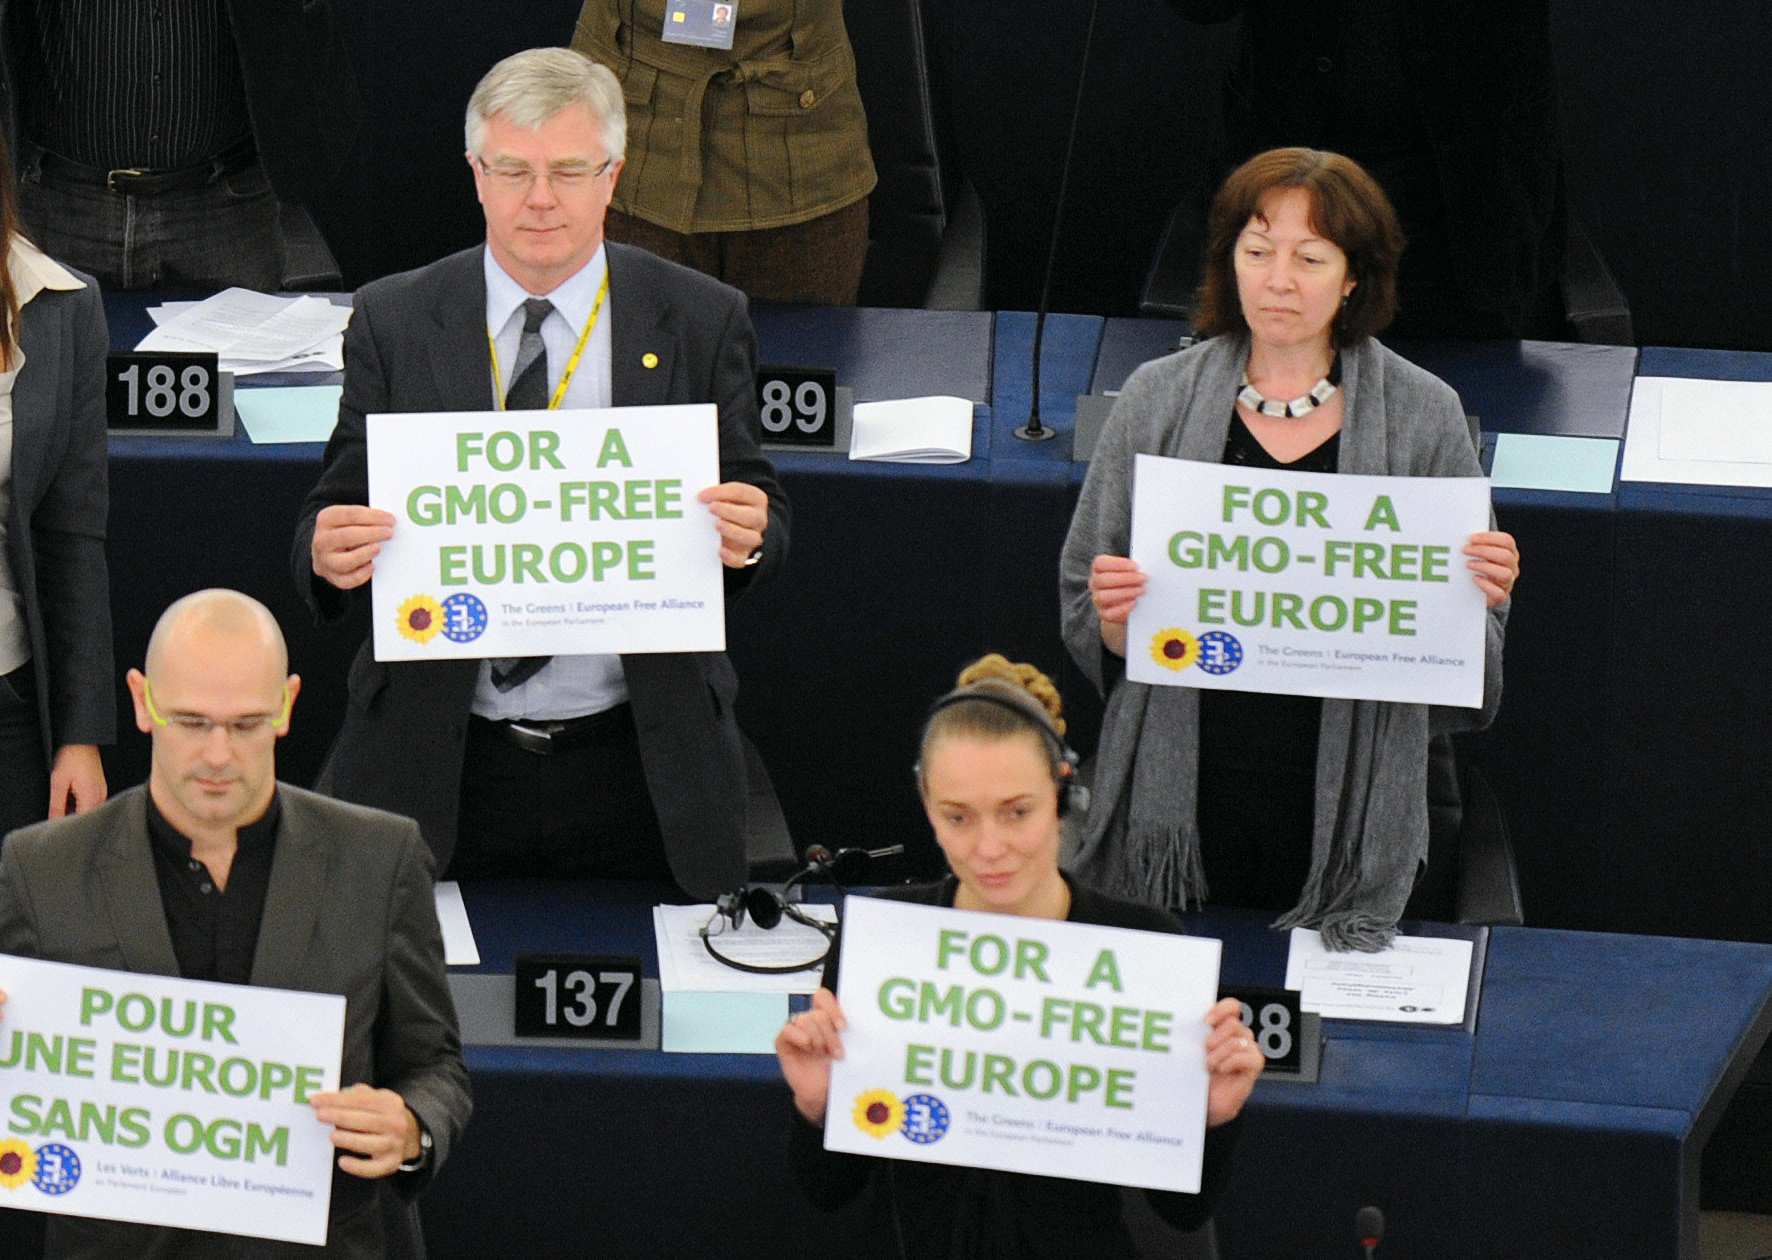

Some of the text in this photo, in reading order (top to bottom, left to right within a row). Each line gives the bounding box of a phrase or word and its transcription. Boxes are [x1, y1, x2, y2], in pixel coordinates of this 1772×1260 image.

[119, 365, 210, 417] 188
[761, 381, 826, 432] 89
[457, 429, 631, 471] FOR A
[407, 479, 681, 525] GMO-FREE
[1223, 485, 1399, 531] FOR A
[440, 540, 654, 584] EUROPE
[1168, 531, 1448, 582] GMO-FREE
[1199, 589, 1416, 635] EUROPE
[937, 930, 1120, 989] FOR A
[81, 989, 235, 1042] POUR
[535, 969, 633, 1026] 137
[878, 978, 1170, 1051] GMO-FREE
[111, 1043, 322, 1104] EUROPE
[905, 1044, 1133, 1108] EUROPE
[11, 1095, 289, 1164] SANS OGM
